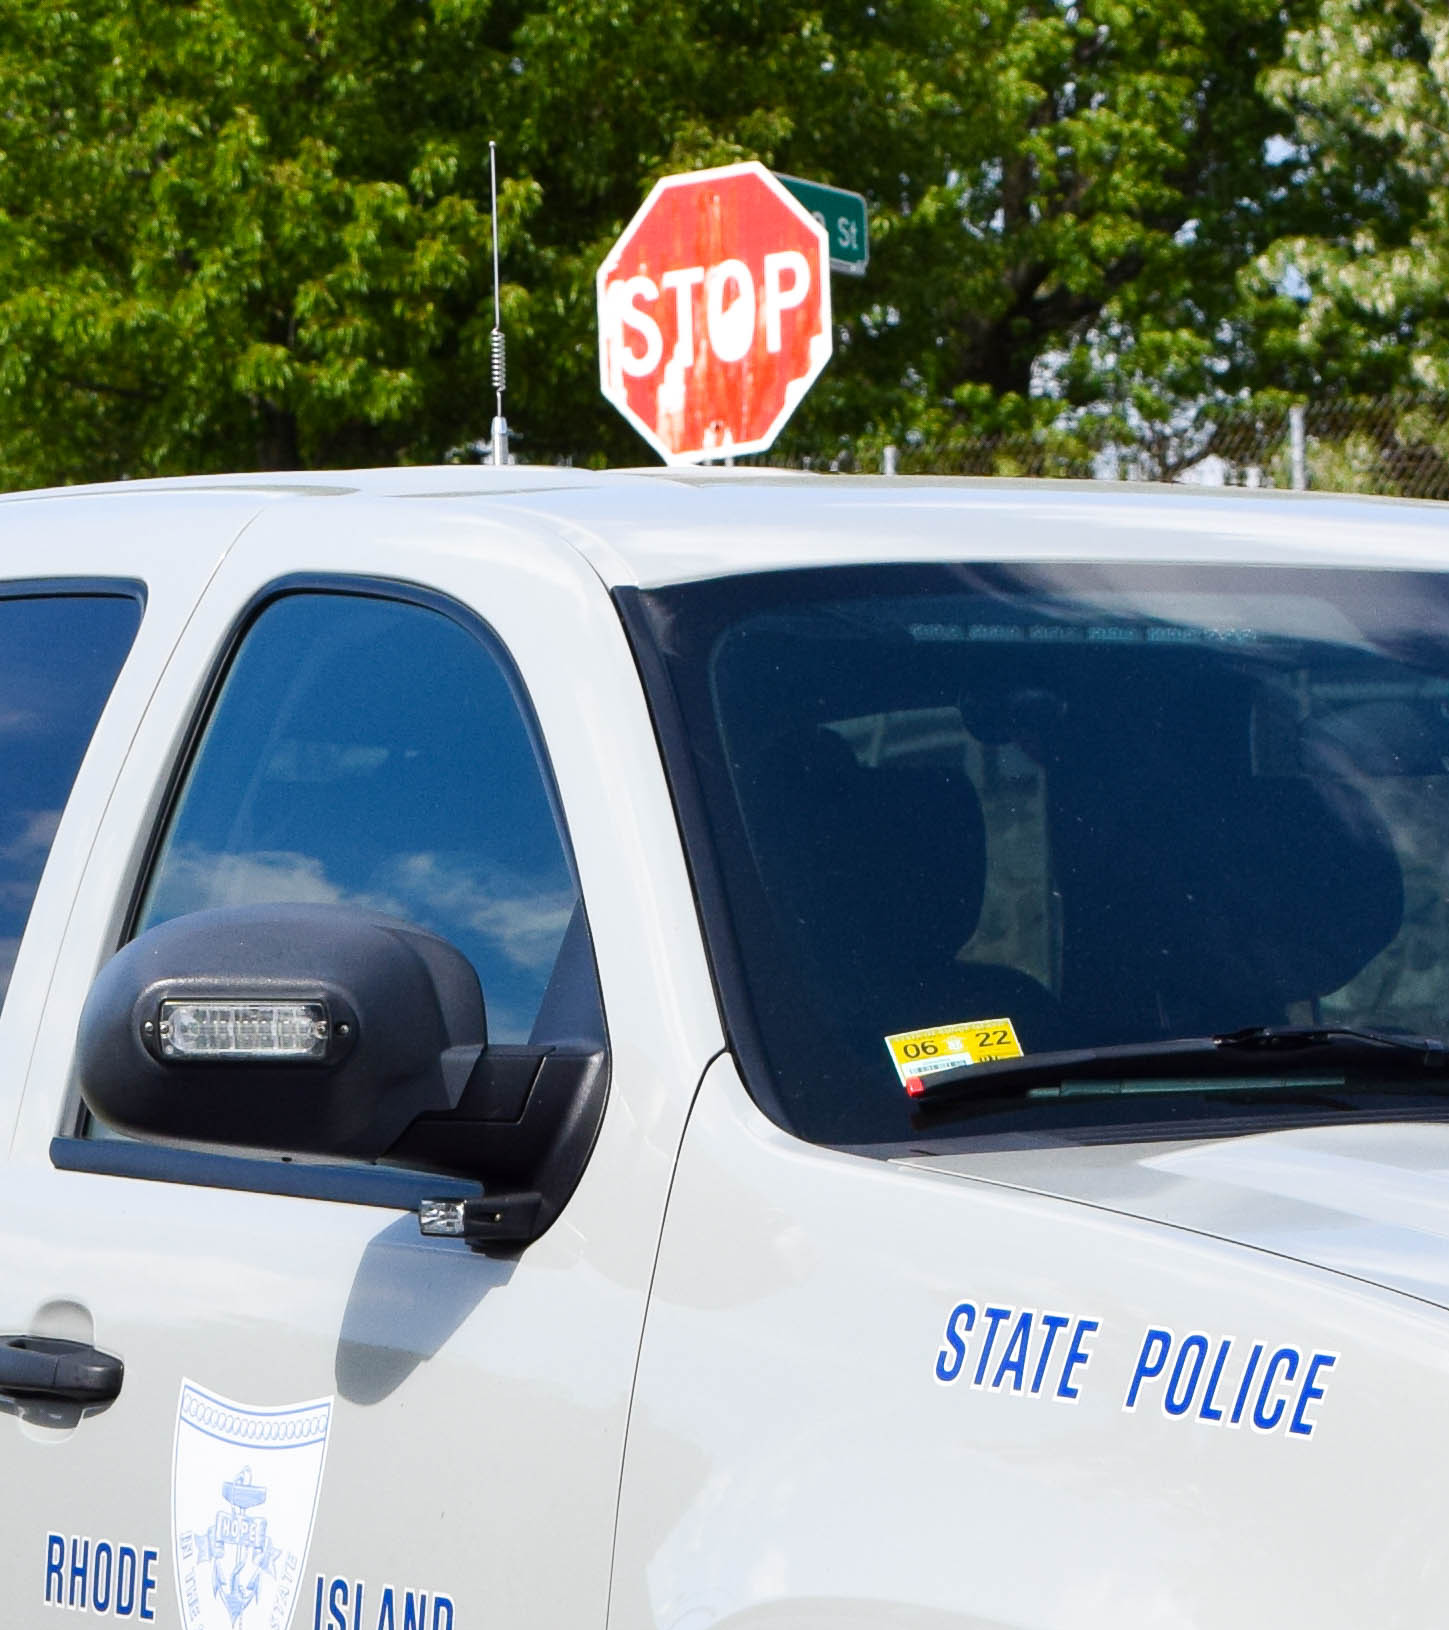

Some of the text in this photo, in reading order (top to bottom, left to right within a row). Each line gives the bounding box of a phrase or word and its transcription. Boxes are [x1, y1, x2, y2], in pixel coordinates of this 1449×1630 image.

[837, 216, 859, 250] St
[620, 250, 812, 379] STOP
[903, 1040, 938, 1059] 06
[975, 1030, 1011, 1048] 22
[935, 1302, 1337, 1437] STATE POLICE
[222, 1516, 258, 1541] HOPE
[44, 1533, 160, 1621] RHODE
